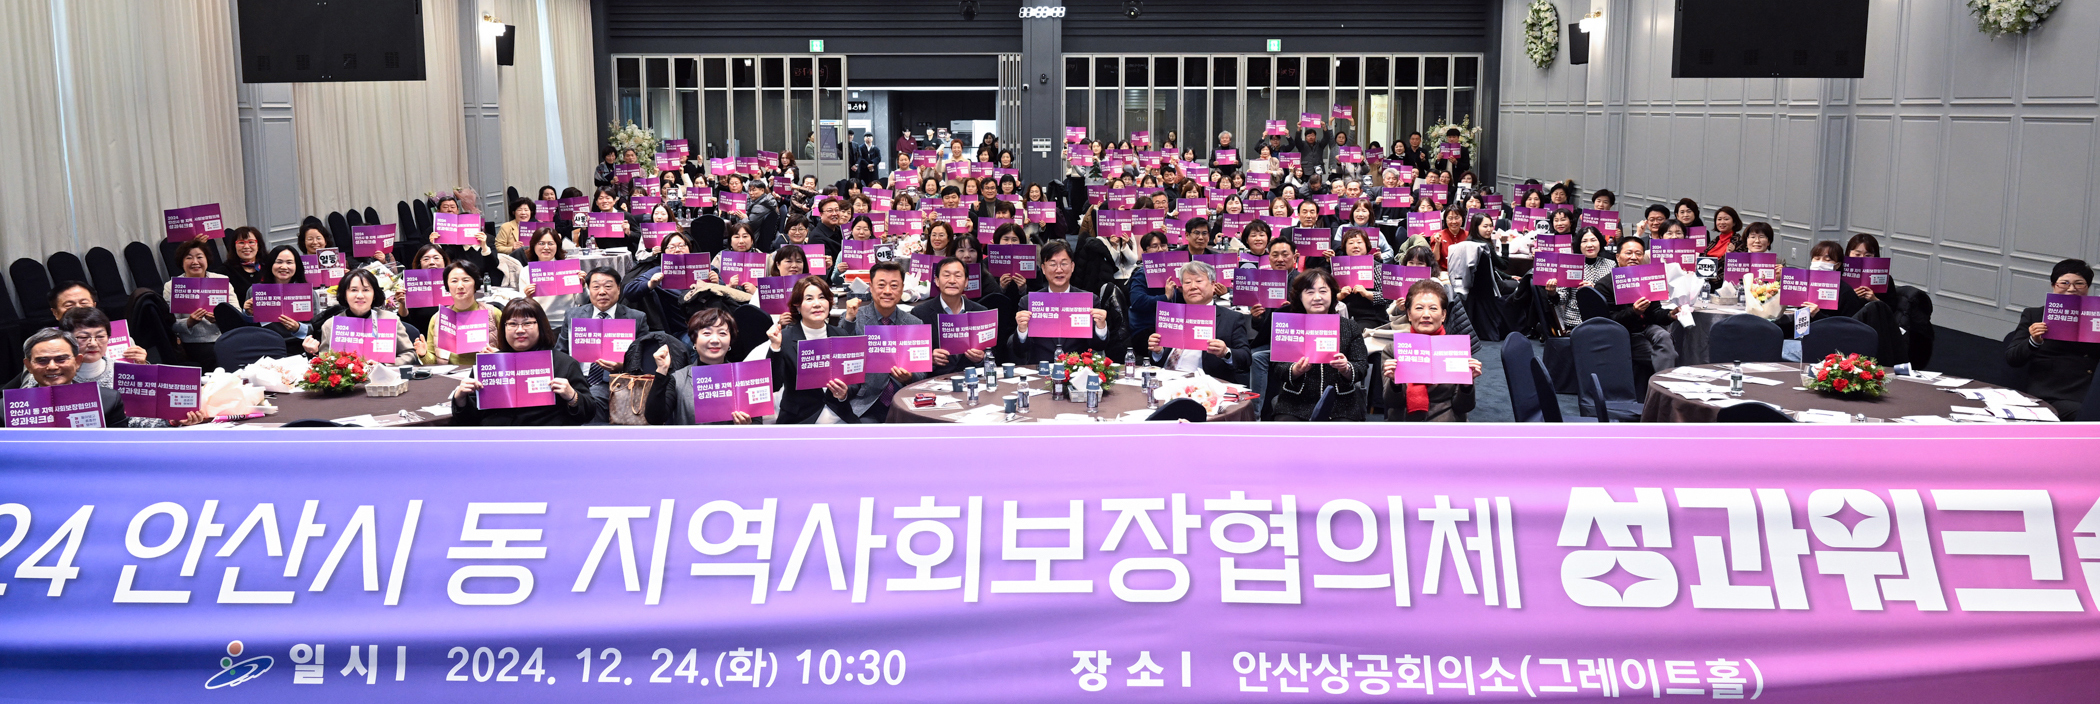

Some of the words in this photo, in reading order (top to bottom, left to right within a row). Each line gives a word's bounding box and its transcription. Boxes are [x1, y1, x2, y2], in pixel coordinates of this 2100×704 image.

[320, 254, 336, 264] 일동
[877, 251, 892, 259] 이동
[801, 361, 830, 370] 성과워크숍
[482, 378, 515, 386] 성과워크숍
[735, 377, 769, 387] 사회보장협의체
[118, 387, 156, 396] 성과워크숍
[698, 389, 732, 399] 성과워크숍
[55, 402, 98, 412] 사회보장협의체
[11, 415, 54, 426] 성과워크숍
[112, 499, 422, 606] 안산시
[446, 502, 548, 606] 동
[571, 490, 1521, 609] 지역사회보장협의체
[1557, 486, 2100, 612] 성과워크
[446, 646, 556, 686] 2024.
[576, 647, 632, 686] 12.
[796, 648, 906, 686] 10:30
[1232, 650, 1764, 700] 안산상공회의소(그레이트홀)
